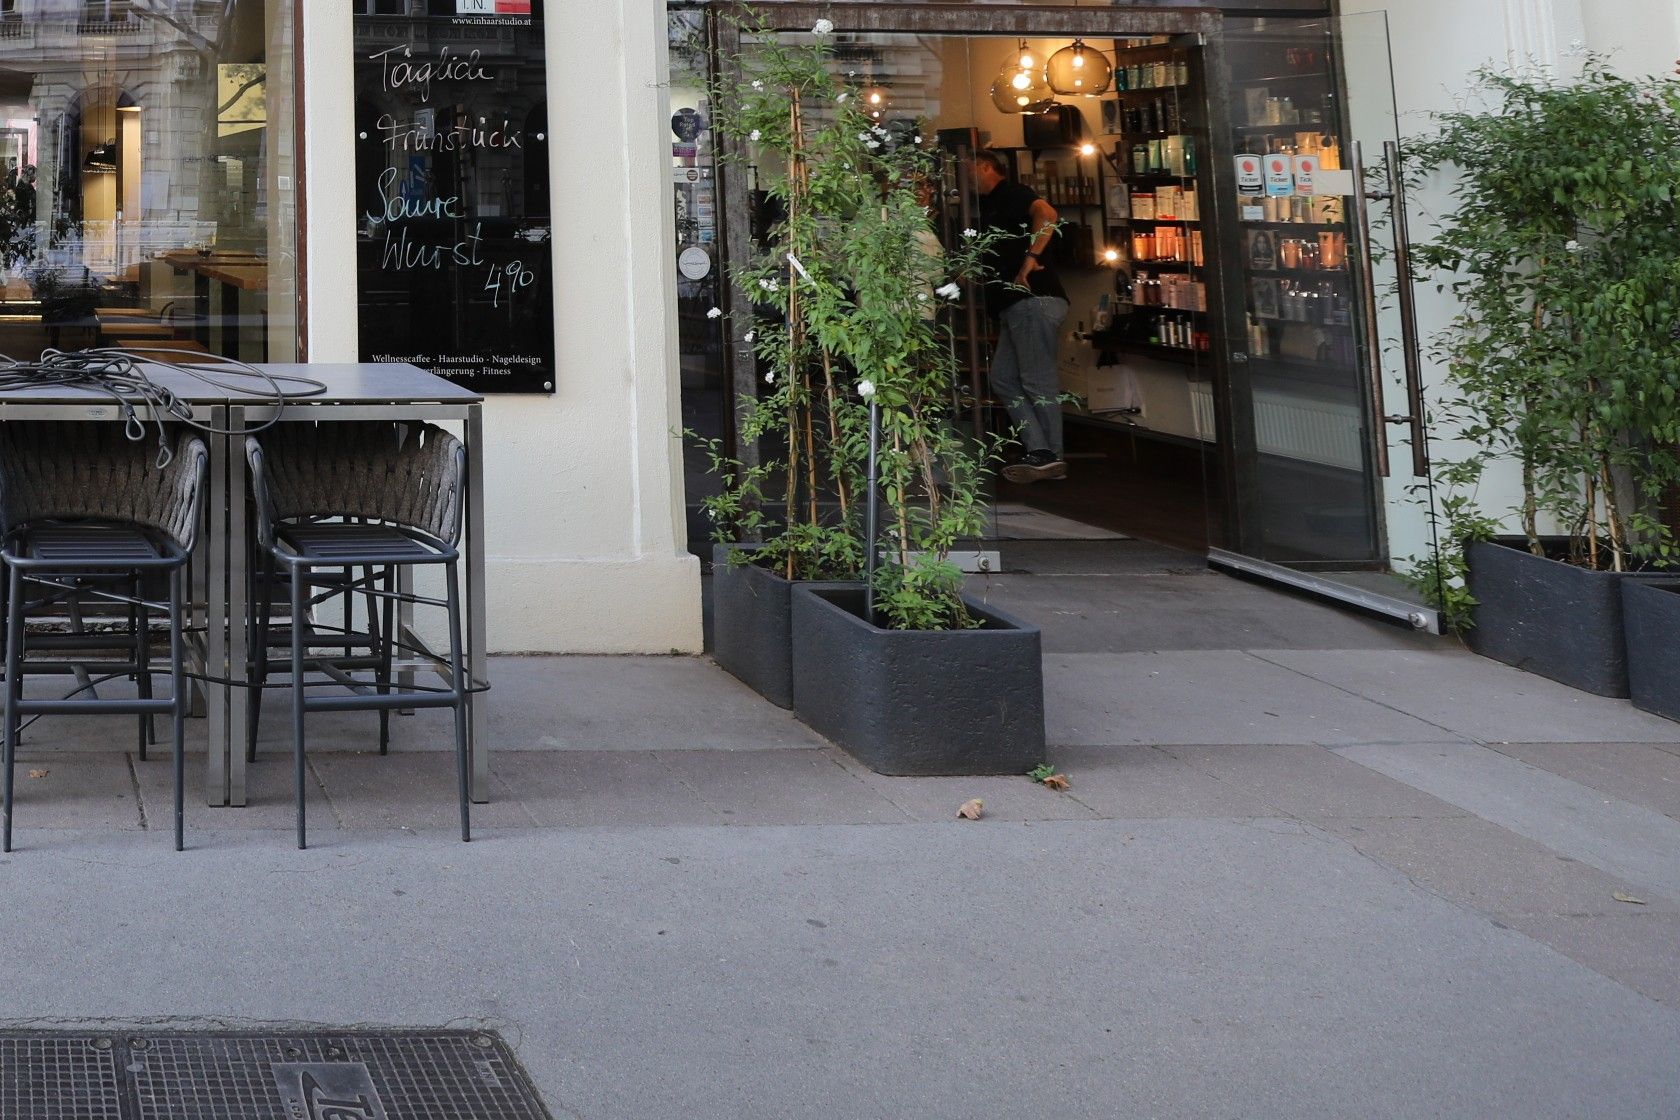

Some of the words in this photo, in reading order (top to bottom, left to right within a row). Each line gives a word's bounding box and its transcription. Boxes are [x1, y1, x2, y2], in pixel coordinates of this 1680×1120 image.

[451, 16, 532, 27] www.inhaarstudio.at
[369, 44, 494, 103] Täglich
[382, 221, 484, 271] Wurst
[371, 353, 431, 364] Wellnesscaffee
[438, 354, 484, 364] Haarstudio
[492, 354, 542, 366] Nageldesign
[425, 366, 475, 377] erlängerung
[482, 366, 512, 376] Fitness
